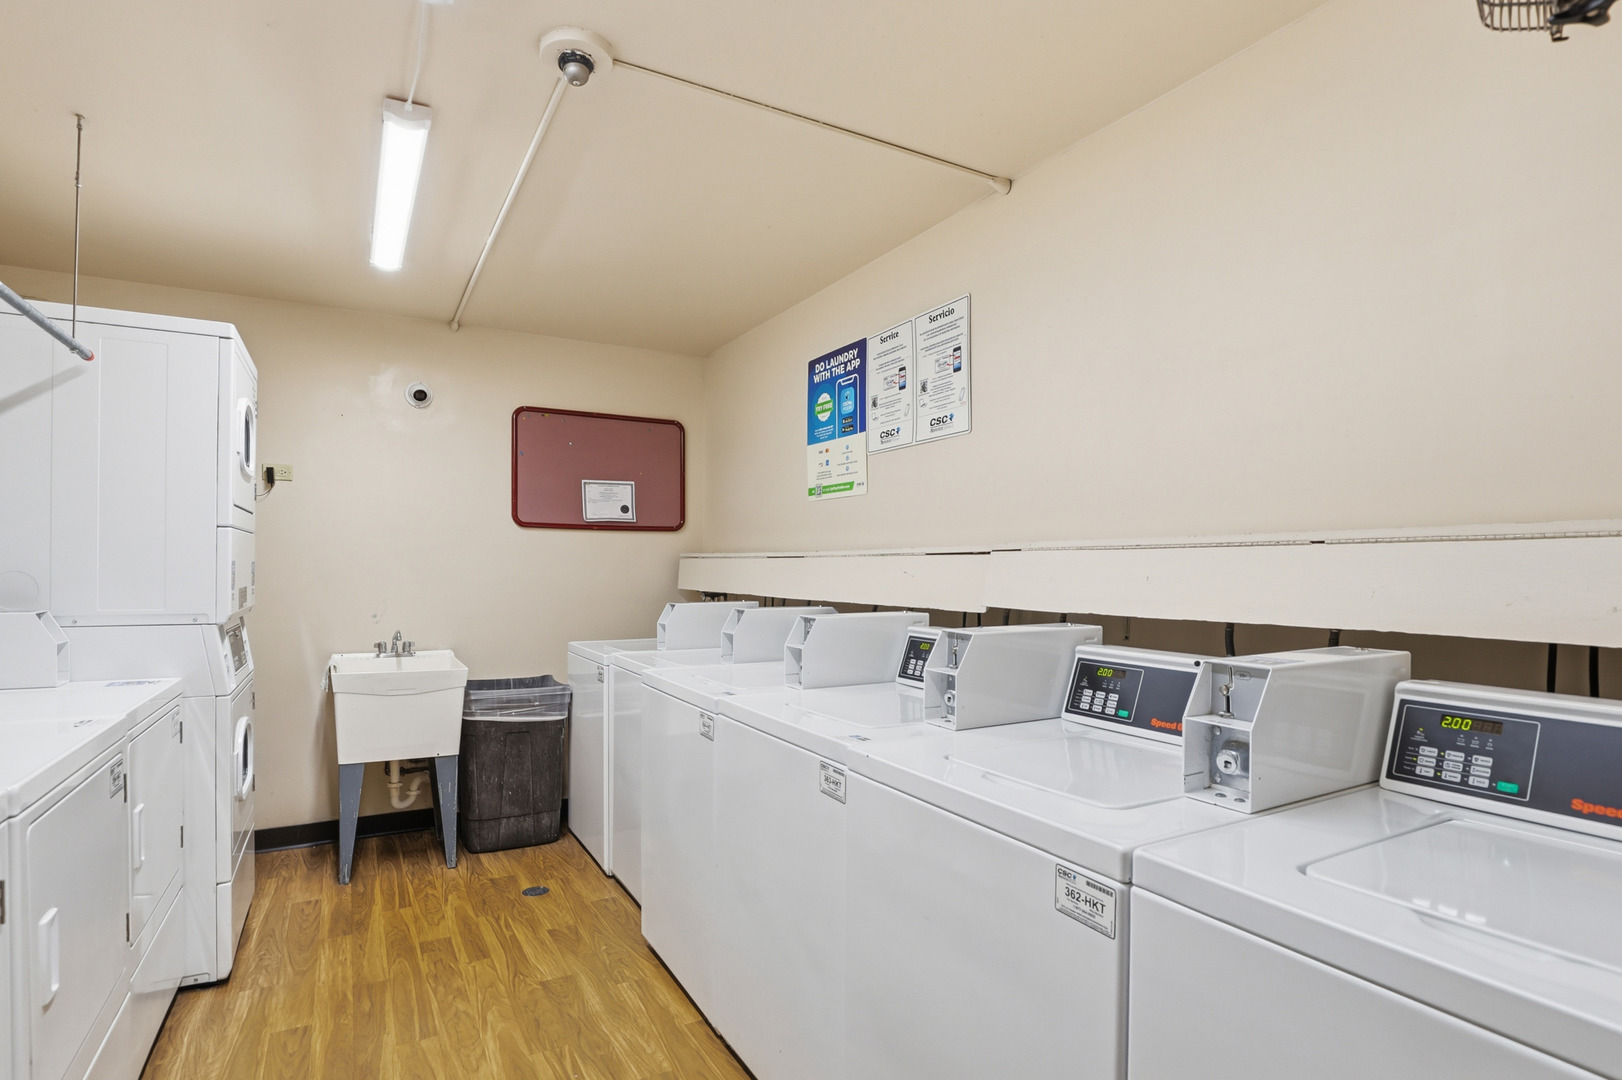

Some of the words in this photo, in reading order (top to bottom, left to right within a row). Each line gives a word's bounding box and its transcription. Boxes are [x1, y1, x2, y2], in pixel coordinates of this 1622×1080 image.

[928, 307, 955, 323] Servicio
[879, 330, 899, 345] Service
[815, 362, 825, 374] DO
[826, 348, 858, 369] LAUNDRY
[813, 369, 831, 383] WITH
[831, 364, 845, 377] THE
[846, 358, 861, 372] APP
[929, 415, 949, 427] CSC
[879, 428, 896, 439] CSC
[1150, 718, 1177, 730] Speed
[1441, 716, 1472, 731] 2.00
[1057, 868, 1072, 879] CSC
[1064, 886, 1106, 914] 362-HKT
